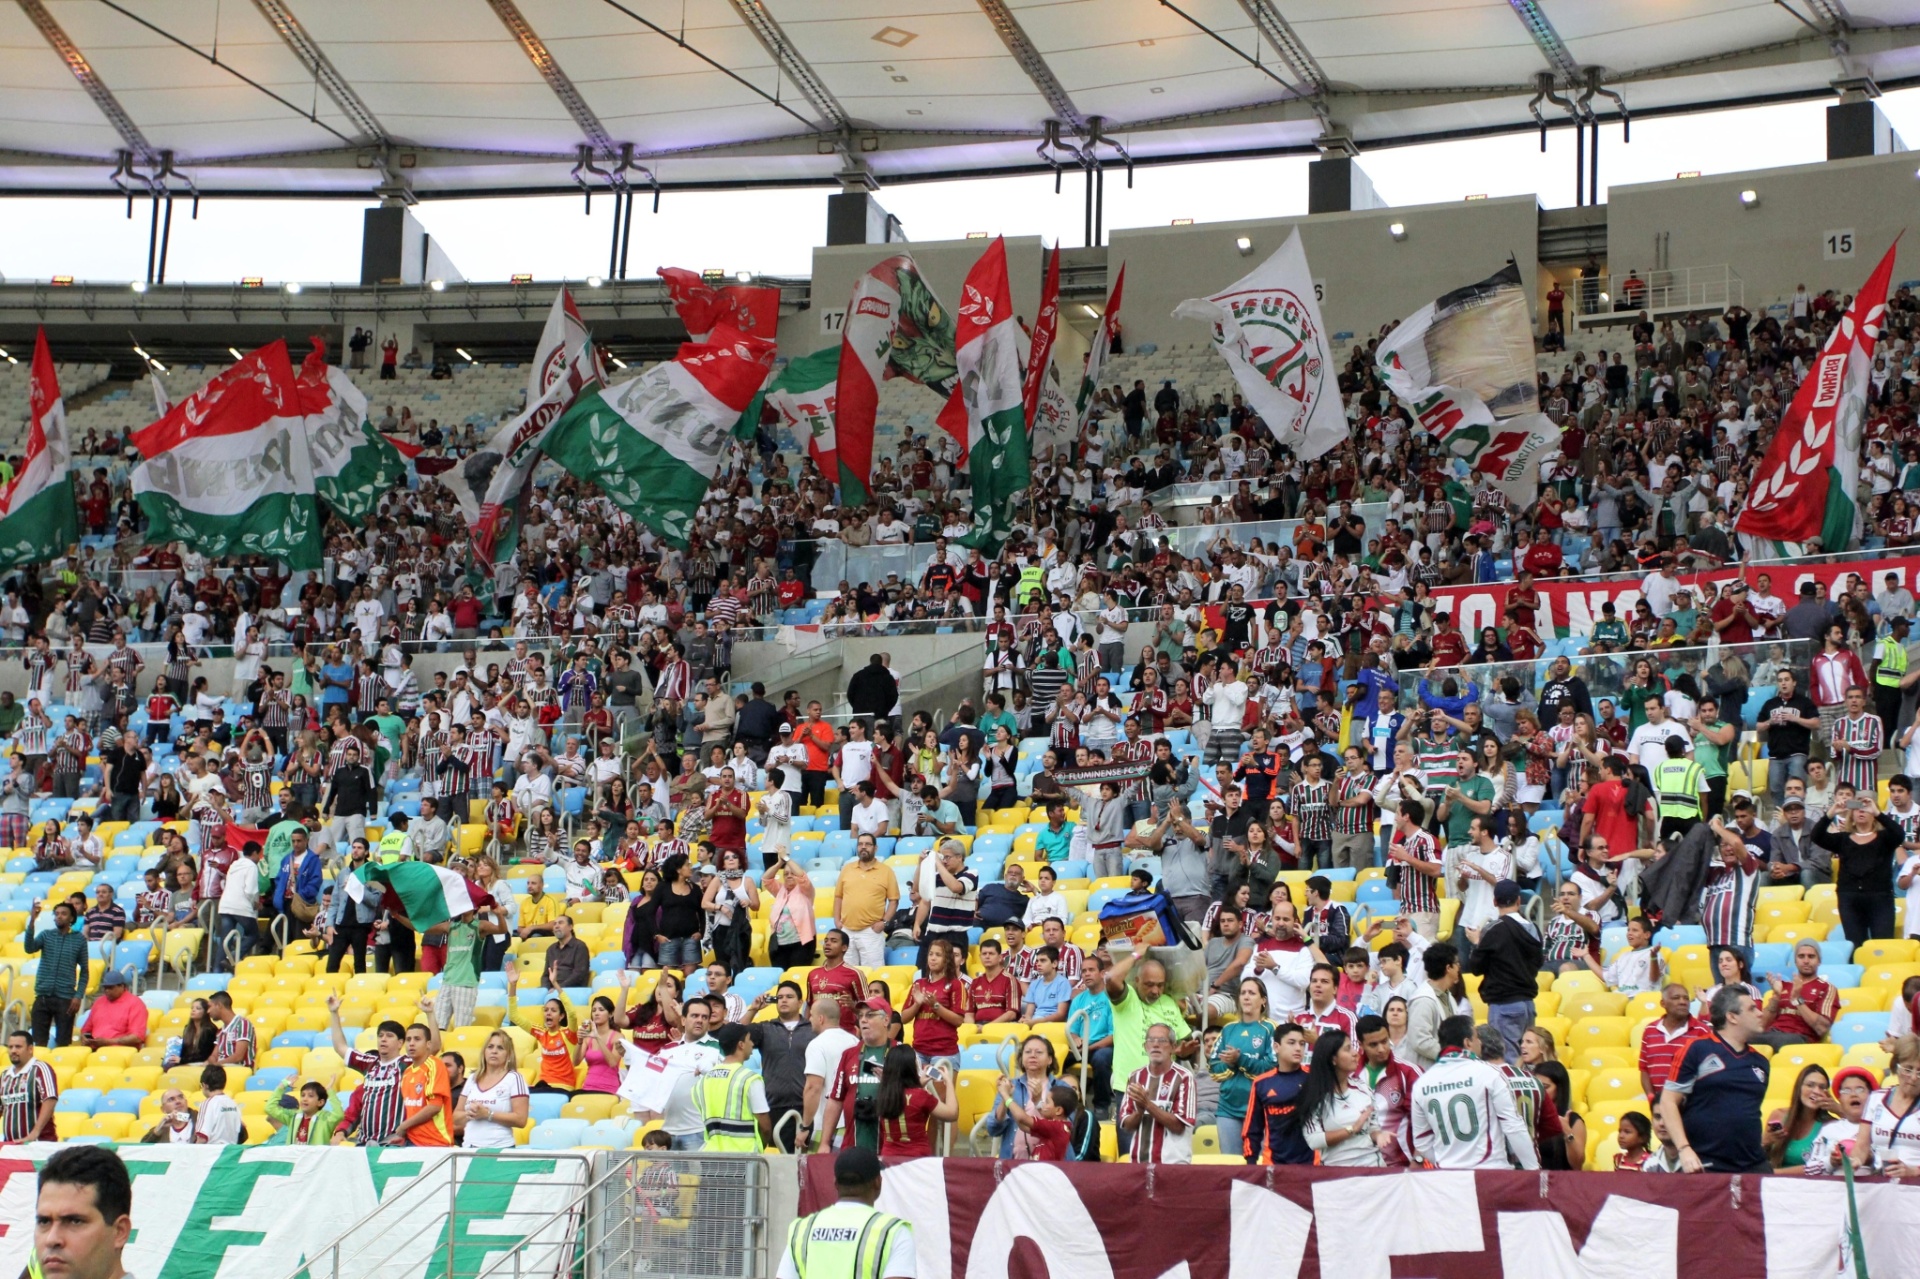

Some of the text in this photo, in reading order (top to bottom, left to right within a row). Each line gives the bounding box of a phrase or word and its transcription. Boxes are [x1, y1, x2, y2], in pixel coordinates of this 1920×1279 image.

[1828, 234, 1852, 254] 15
[823, 313, 845, 330] 17
[1817, 357, 1841, 404] BRAHMA
[251, 772, 263, 788] 9
[1068, 769, 1122, 781] FLUMINENSE
[633, 1029, 667, 1040] Unimed
[364, 1076, 396, 1087] Unimed
[849, 1073, 881, 1085] Unim
[1422, 1076, 1474, 1096] Unimed
[1509, 1077, 1536, 1090] imed
[1427, 1093, 1479, 1146] 10
[812, 1227, 858, 1242] SUNSET
